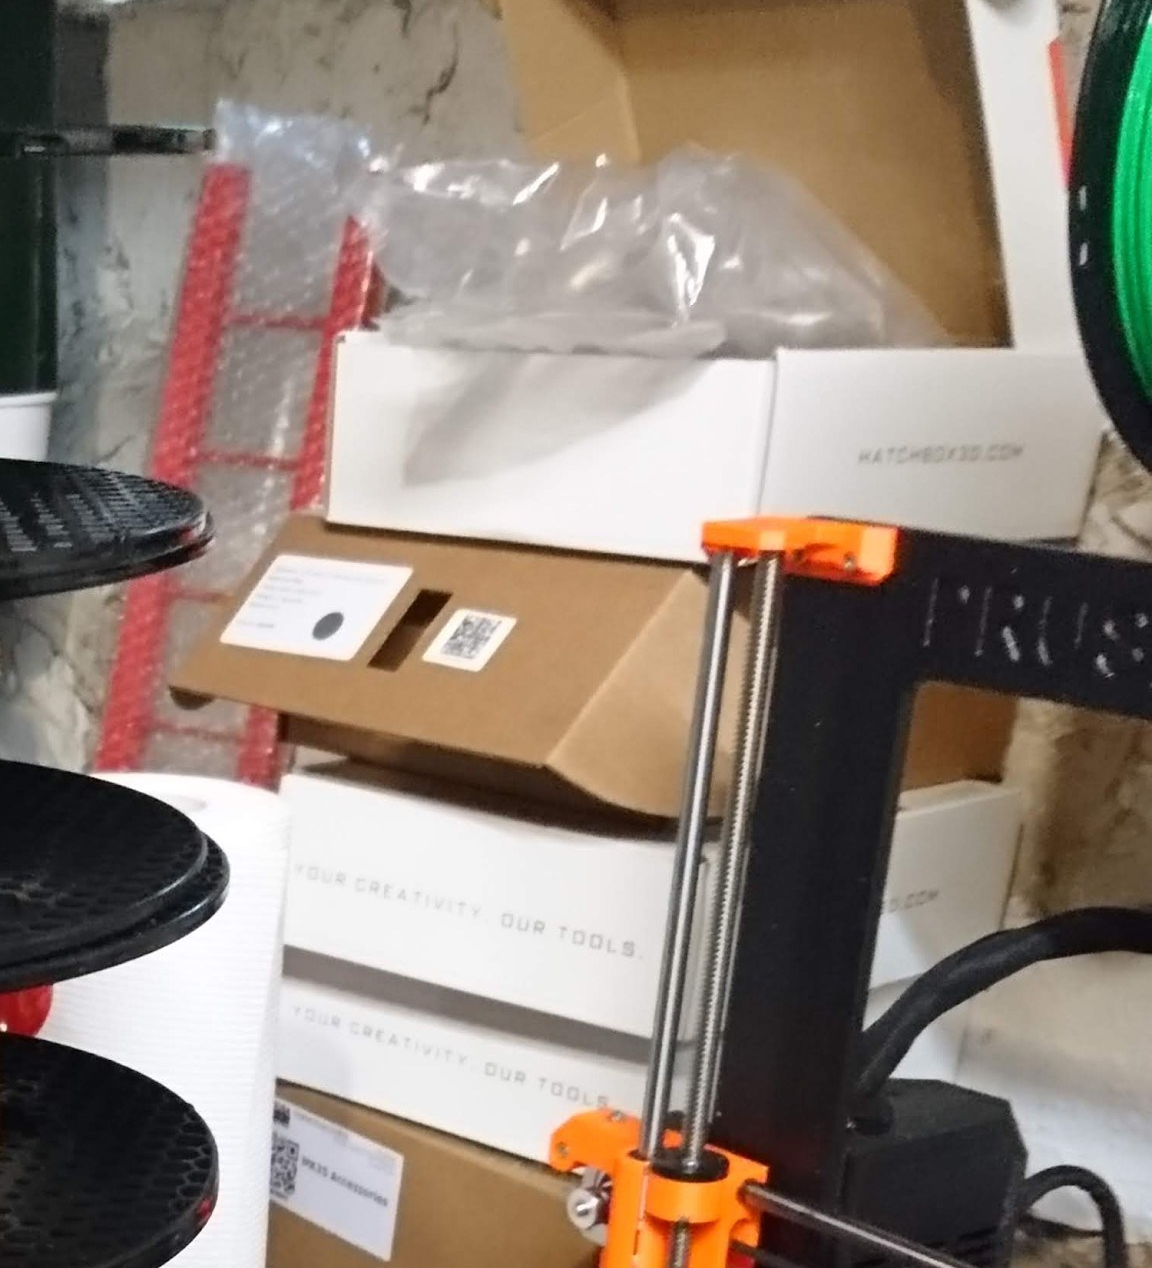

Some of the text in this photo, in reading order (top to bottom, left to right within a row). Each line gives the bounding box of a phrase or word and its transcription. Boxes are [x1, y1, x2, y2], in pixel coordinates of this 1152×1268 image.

[922, 577, 1152, 690] PRUS
[294, 862, 347, 887] YOUR
[500, 911, 547, 936] OUR
[557, 925, 645, 960] TOOLS.
[292, 1005, 341, 1029] YOUR
[483, 1061, 527, 1085] OUR
